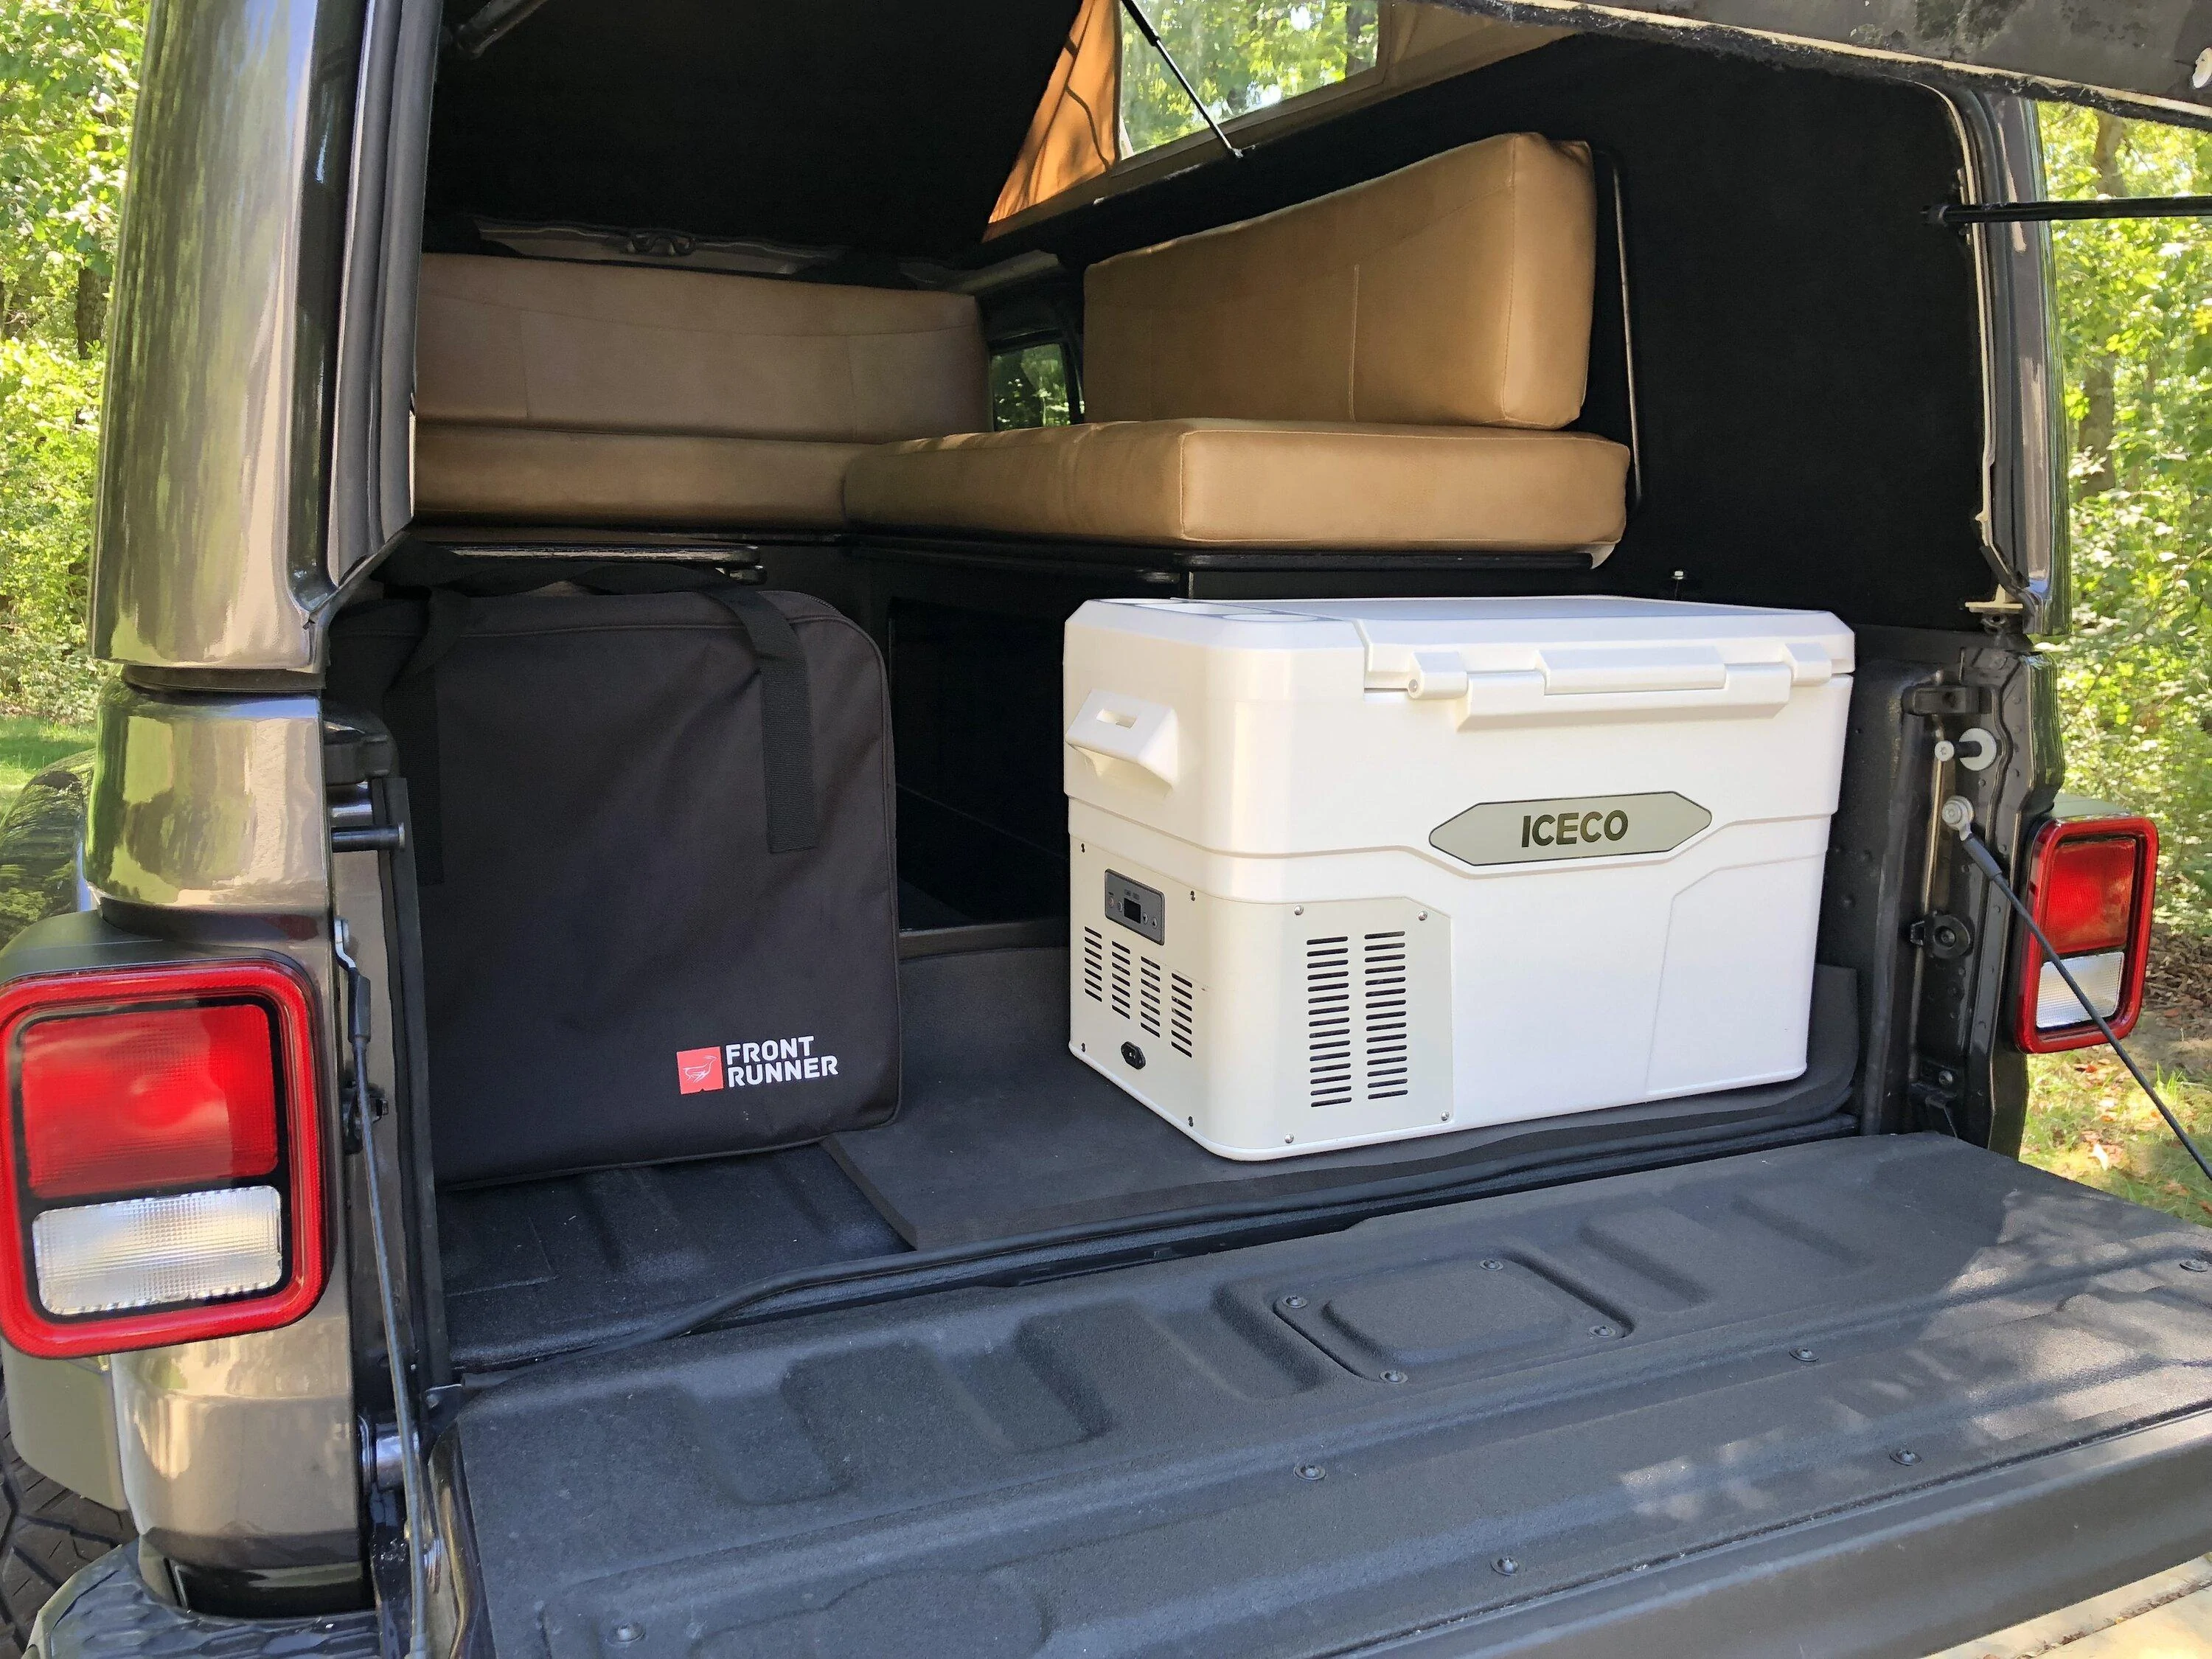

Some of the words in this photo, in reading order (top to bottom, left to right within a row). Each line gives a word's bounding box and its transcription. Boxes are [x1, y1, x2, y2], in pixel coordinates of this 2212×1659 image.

[1521, 810, 1629, 848] ICECO
[726, 1035, 815, 1065] FRONT
[727, 1055, 839, 1088] RUNNER
